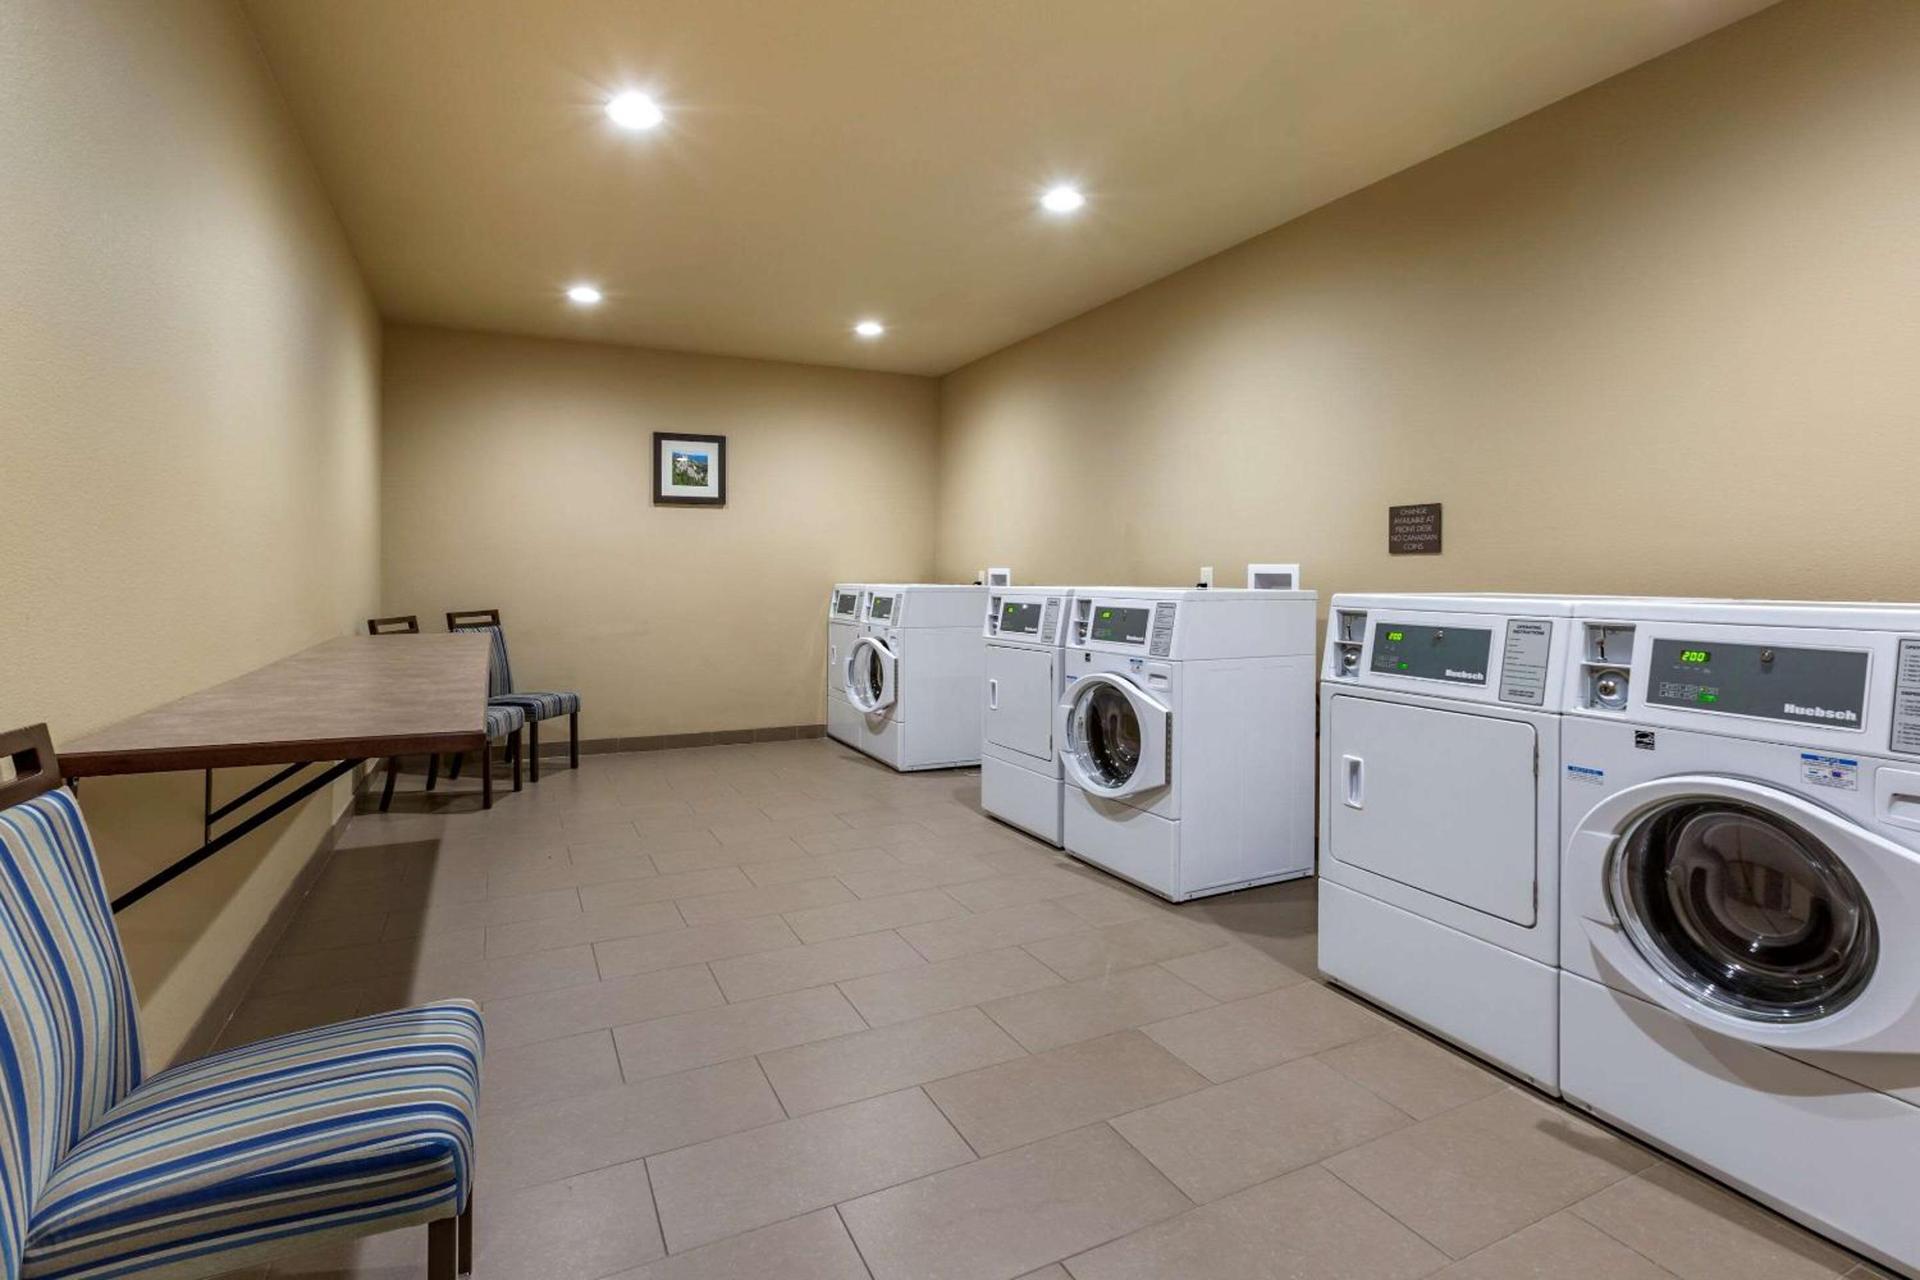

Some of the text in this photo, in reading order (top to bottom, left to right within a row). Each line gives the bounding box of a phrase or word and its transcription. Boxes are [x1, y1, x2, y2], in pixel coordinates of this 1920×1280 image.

[1391, 534, 1402, 542] NO
[1682, 651, 1706, 662] 200
[1784, 703, 1857, 721] Huebsch
